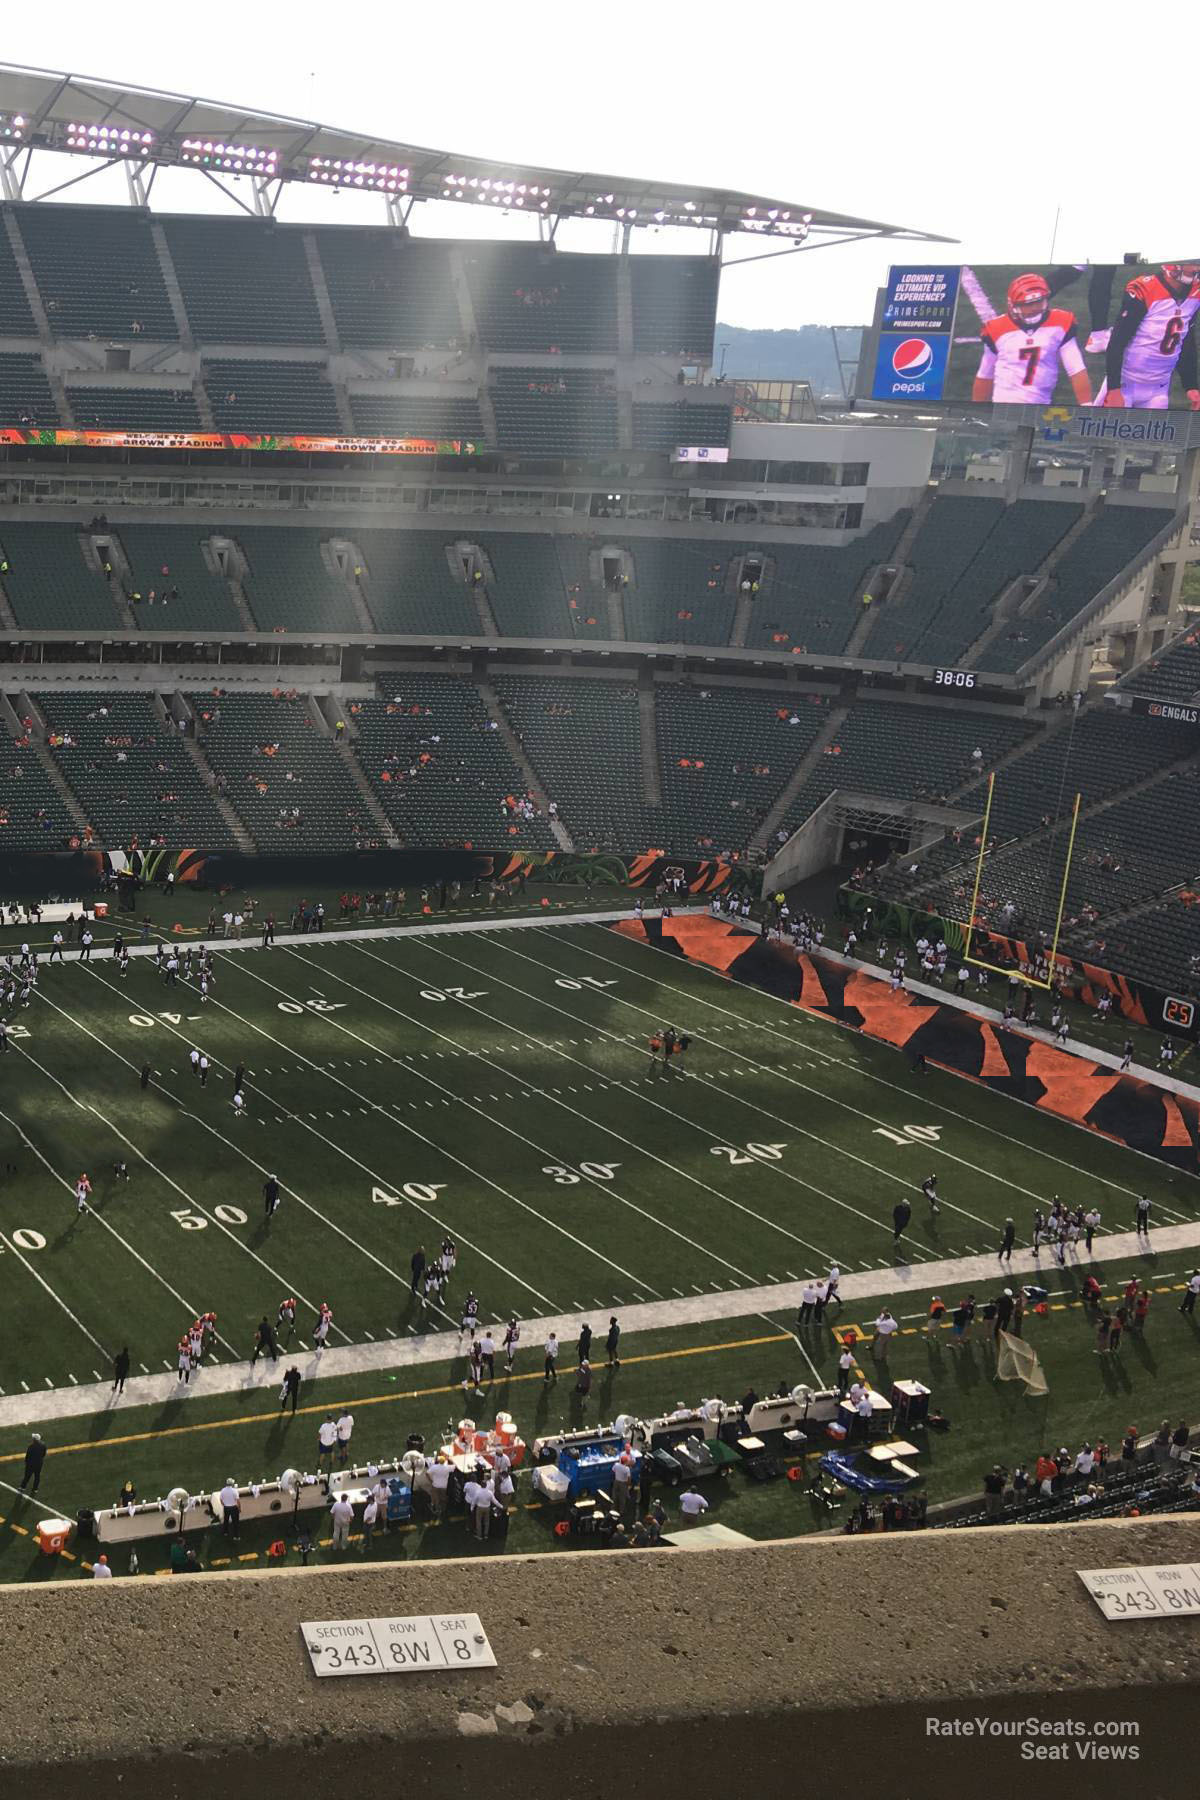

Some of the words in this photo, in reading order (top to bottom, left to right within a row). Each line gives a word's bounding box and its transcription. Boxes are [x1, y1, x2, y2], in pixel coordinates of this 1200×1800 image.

[896, 283, 931, 292] ULTIMATE
[933, 283, 946, 292] VIP
[901, 274, 935, 283] LOOKING
[894, 293, 946, 302] EXPERIENCE?
[1019, 346, 1041, 386] 7
[892, 382, 926, 394] pepsi
[1078, 417, 1175, 440] TriHealth
[381, 445, 435, 453] STADIUM
[935, 670, 975, 688] 38:06
[1168, 1001, 1188, 1024] 25
[872, 1124, 939, 1146] 10
[710, 1142, 784, 1165] 20
[541, 1161, 615, 1185] 30
[371, 1181, 439, 1208] 40
[170, 1203, 248, 1232] 50
[50, 1535, 62, 1548] G
[1092, 1573, 1136, 1586] SECTION
[1156, 1571, 1182, 1582] ROW
[1107, 1590, 1157, 1613] 343
[1163, 1587, 1200, 1610] 8W
[316, 1626, 365, 1639] SECTION
[389, 1623, 417, 1634] ROW
[440, 1619, 469, 1632] SEAT
[325, 1644, 377, 1668] 343
[390, 1640, 431, 1664] 8W
[453, 1639, 472, 1660] 8
